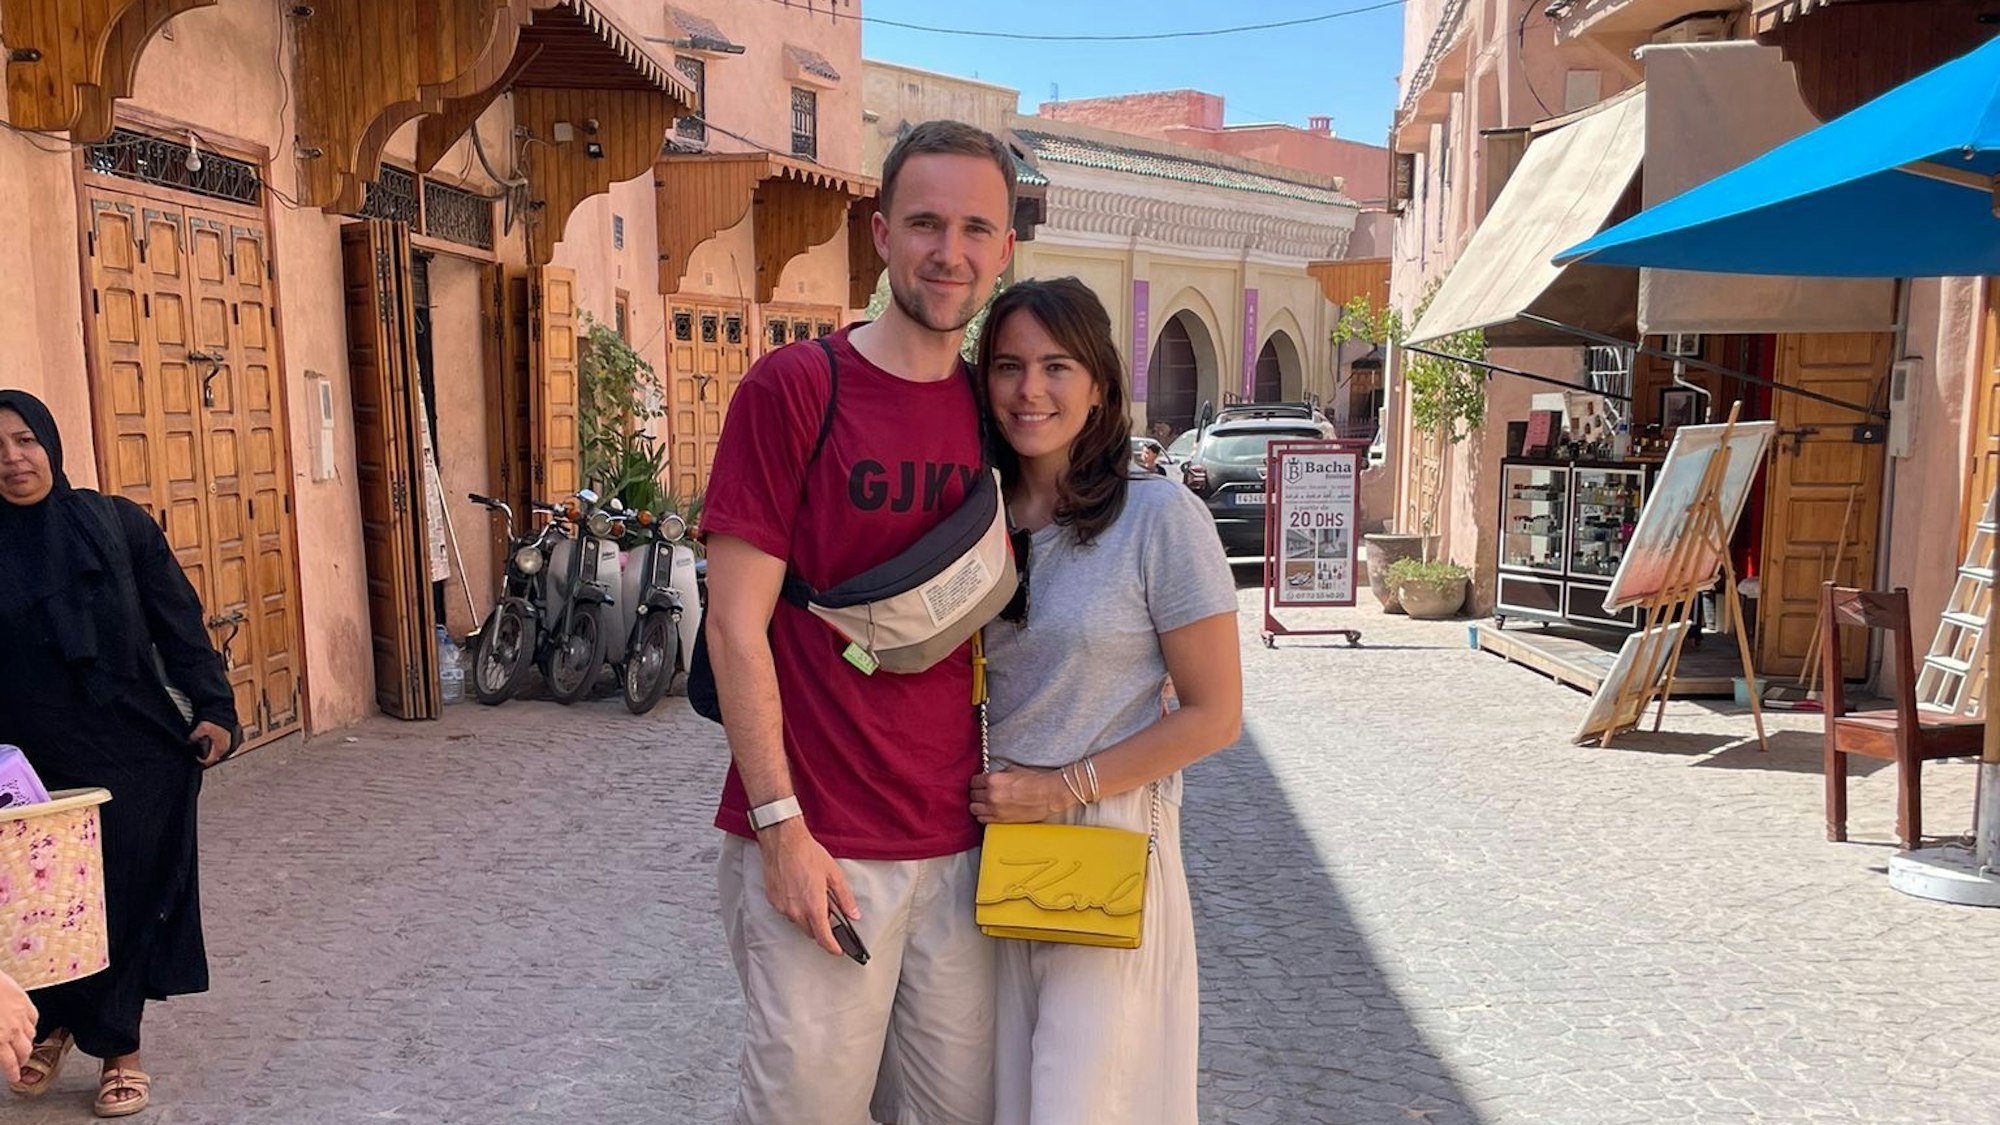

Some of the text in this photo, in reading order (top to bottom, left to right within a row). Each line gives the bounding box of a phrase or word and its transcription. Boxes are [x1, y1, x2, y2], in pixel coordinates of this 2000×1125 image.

[1289, 465, 1299, 480] B
[1306, 461, 1351, 473] Bacha
[1290, 512, 1344, 528] 20 DHS
